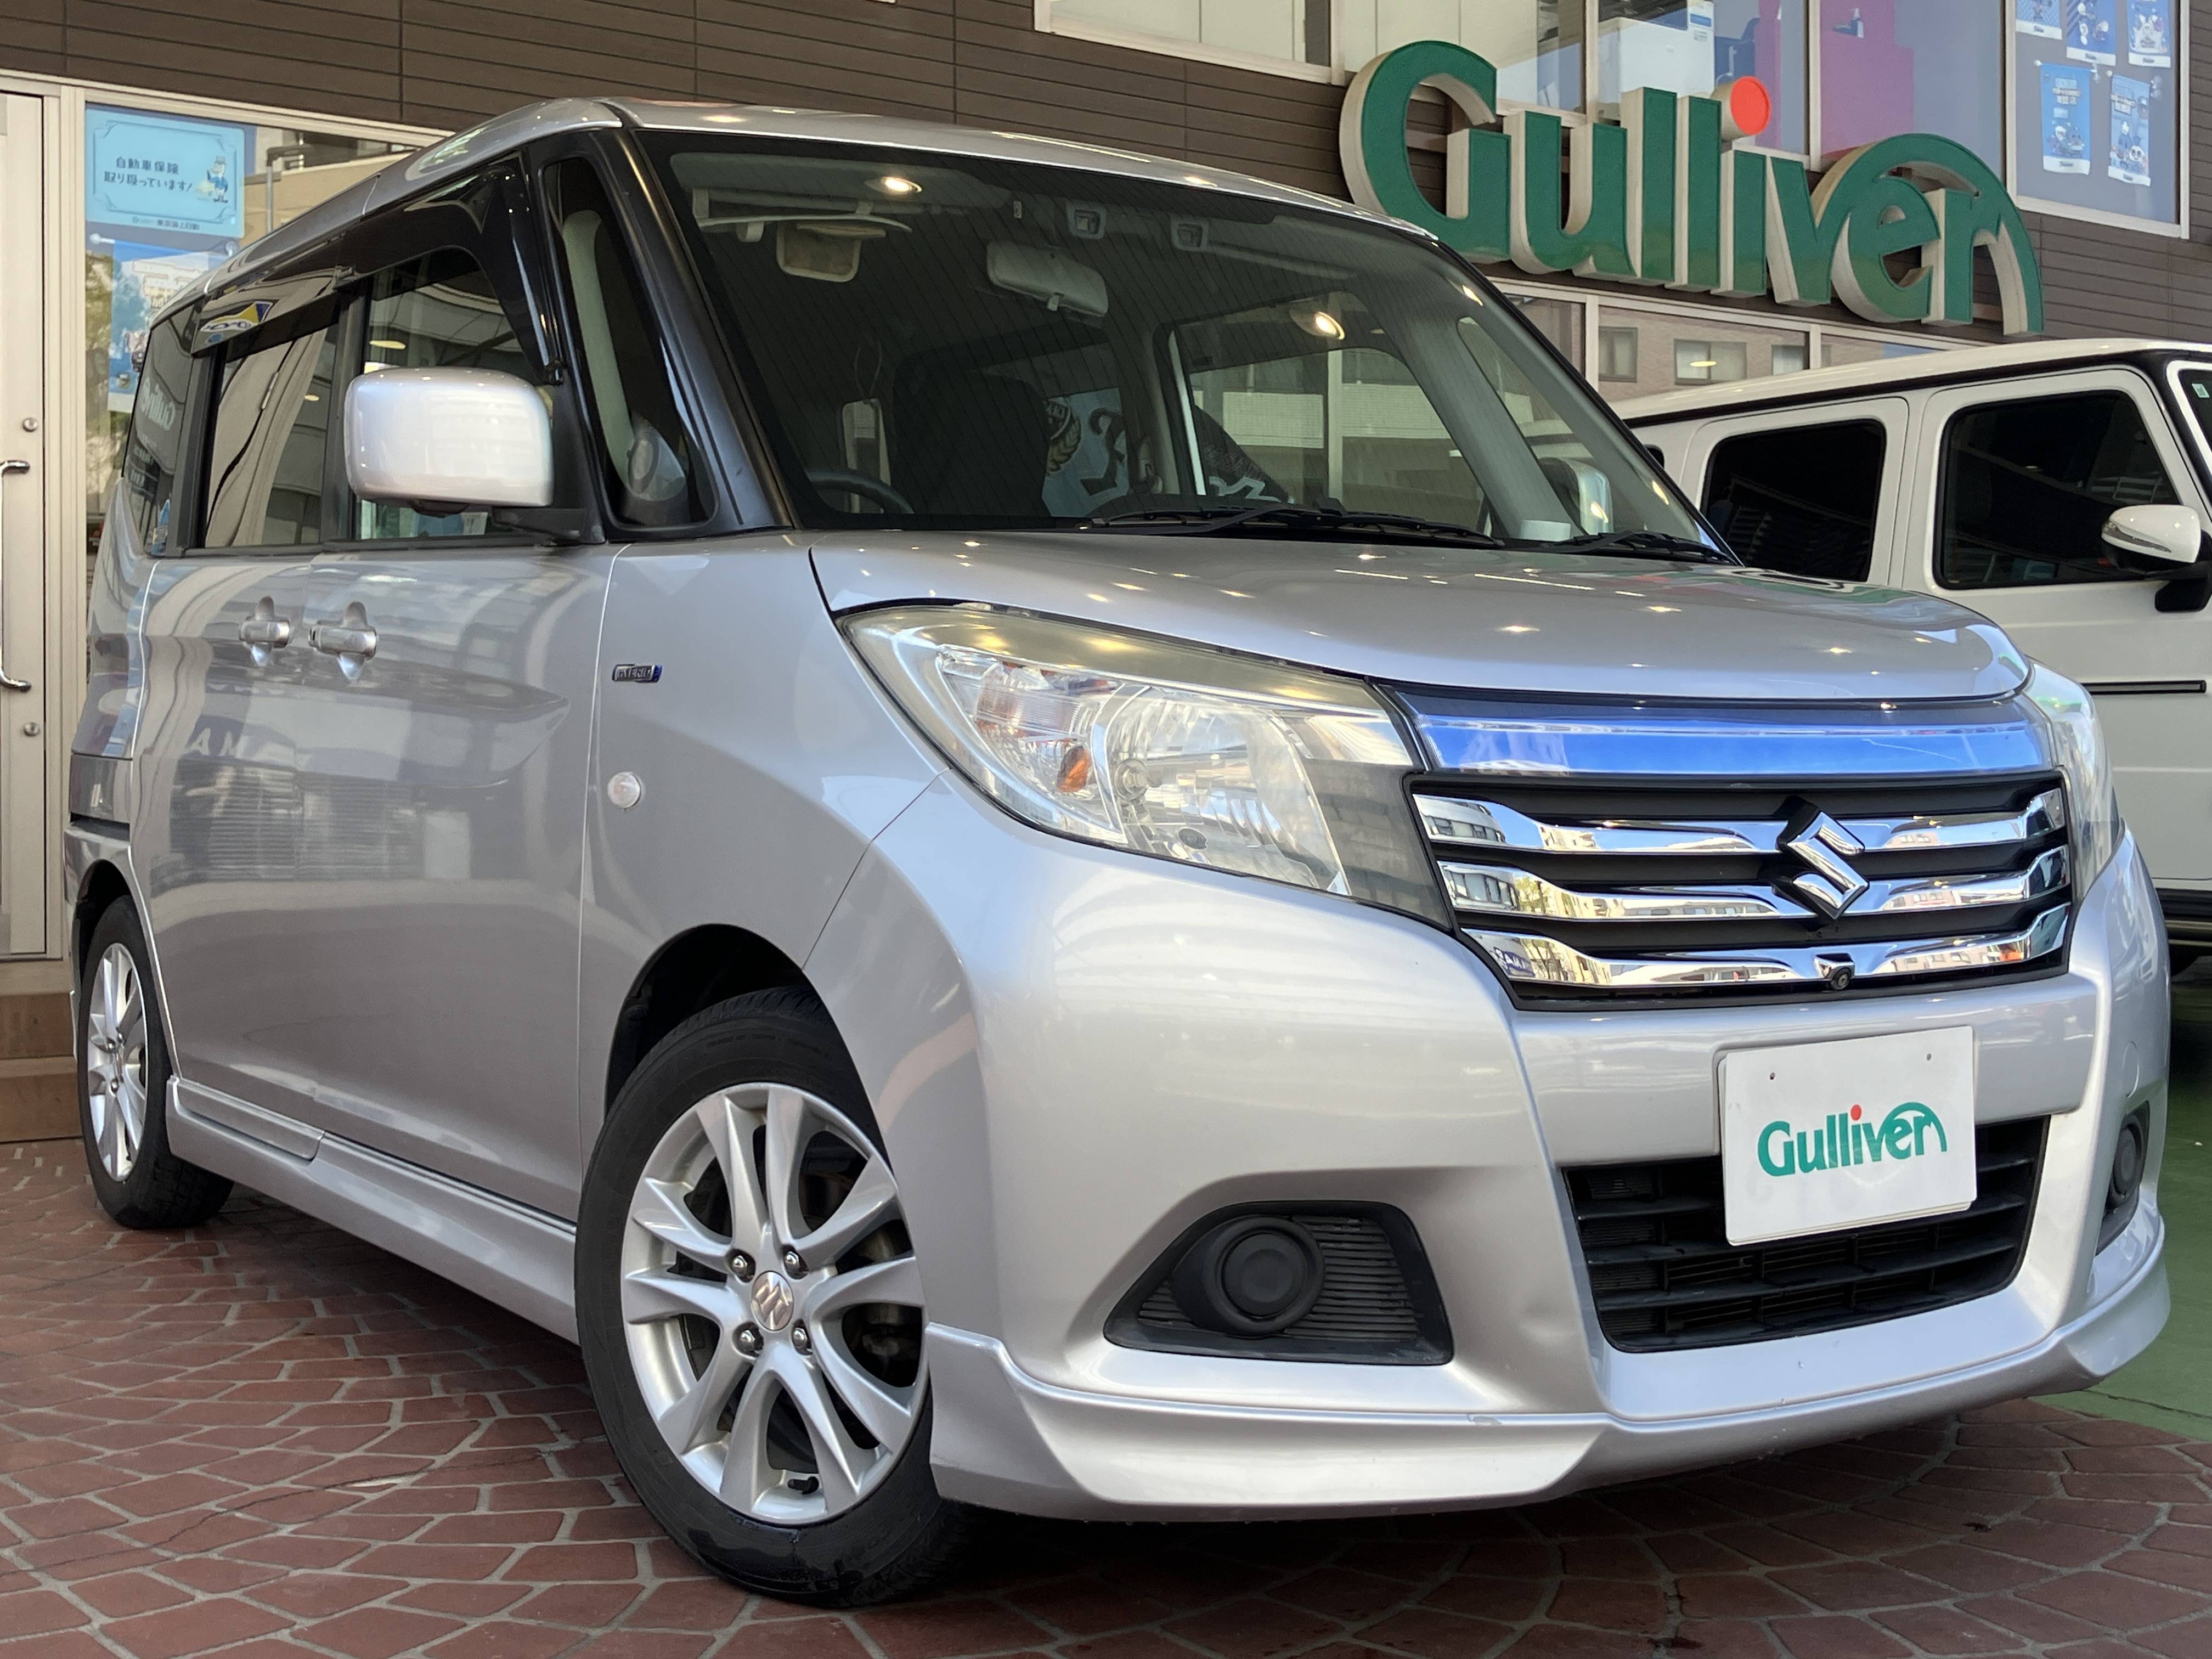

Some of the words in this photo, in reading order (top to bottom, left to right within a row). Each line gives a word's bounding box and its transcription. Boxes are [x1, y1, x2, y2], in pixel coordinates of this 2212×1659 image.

[116, 155, 179, 174] 自動車保険
[1341, 40, 2044, 335] Gulliver
[1757, 1102, 1948, 1177] Gulliver
